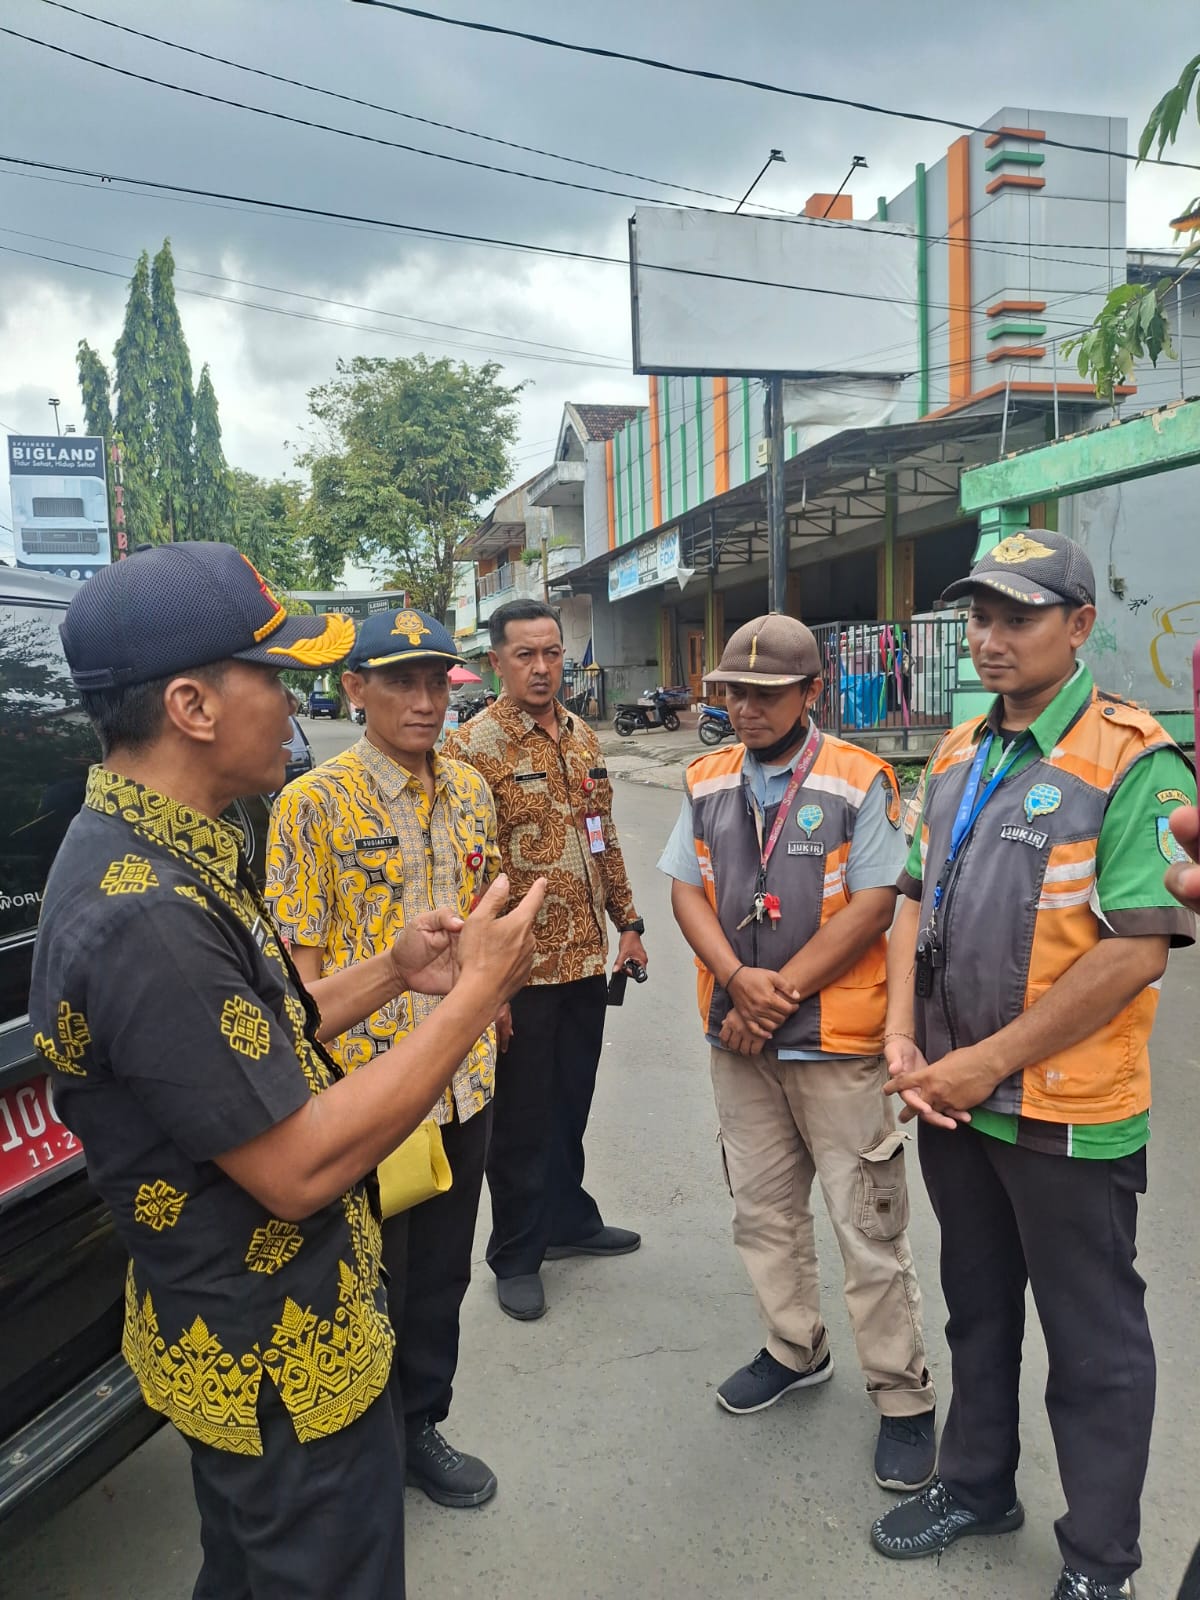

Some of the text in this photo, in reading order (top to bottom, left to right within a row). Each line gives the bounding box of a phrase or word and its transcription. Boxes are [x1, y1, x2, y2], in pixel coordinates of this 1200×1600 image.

[12, 447, 96, 461] BIGLAND
[1005, 826, 1042, 845] JUKIR
[791, 843, 821, 853] JUKIR
[0, 891, 43, 910] WORL
